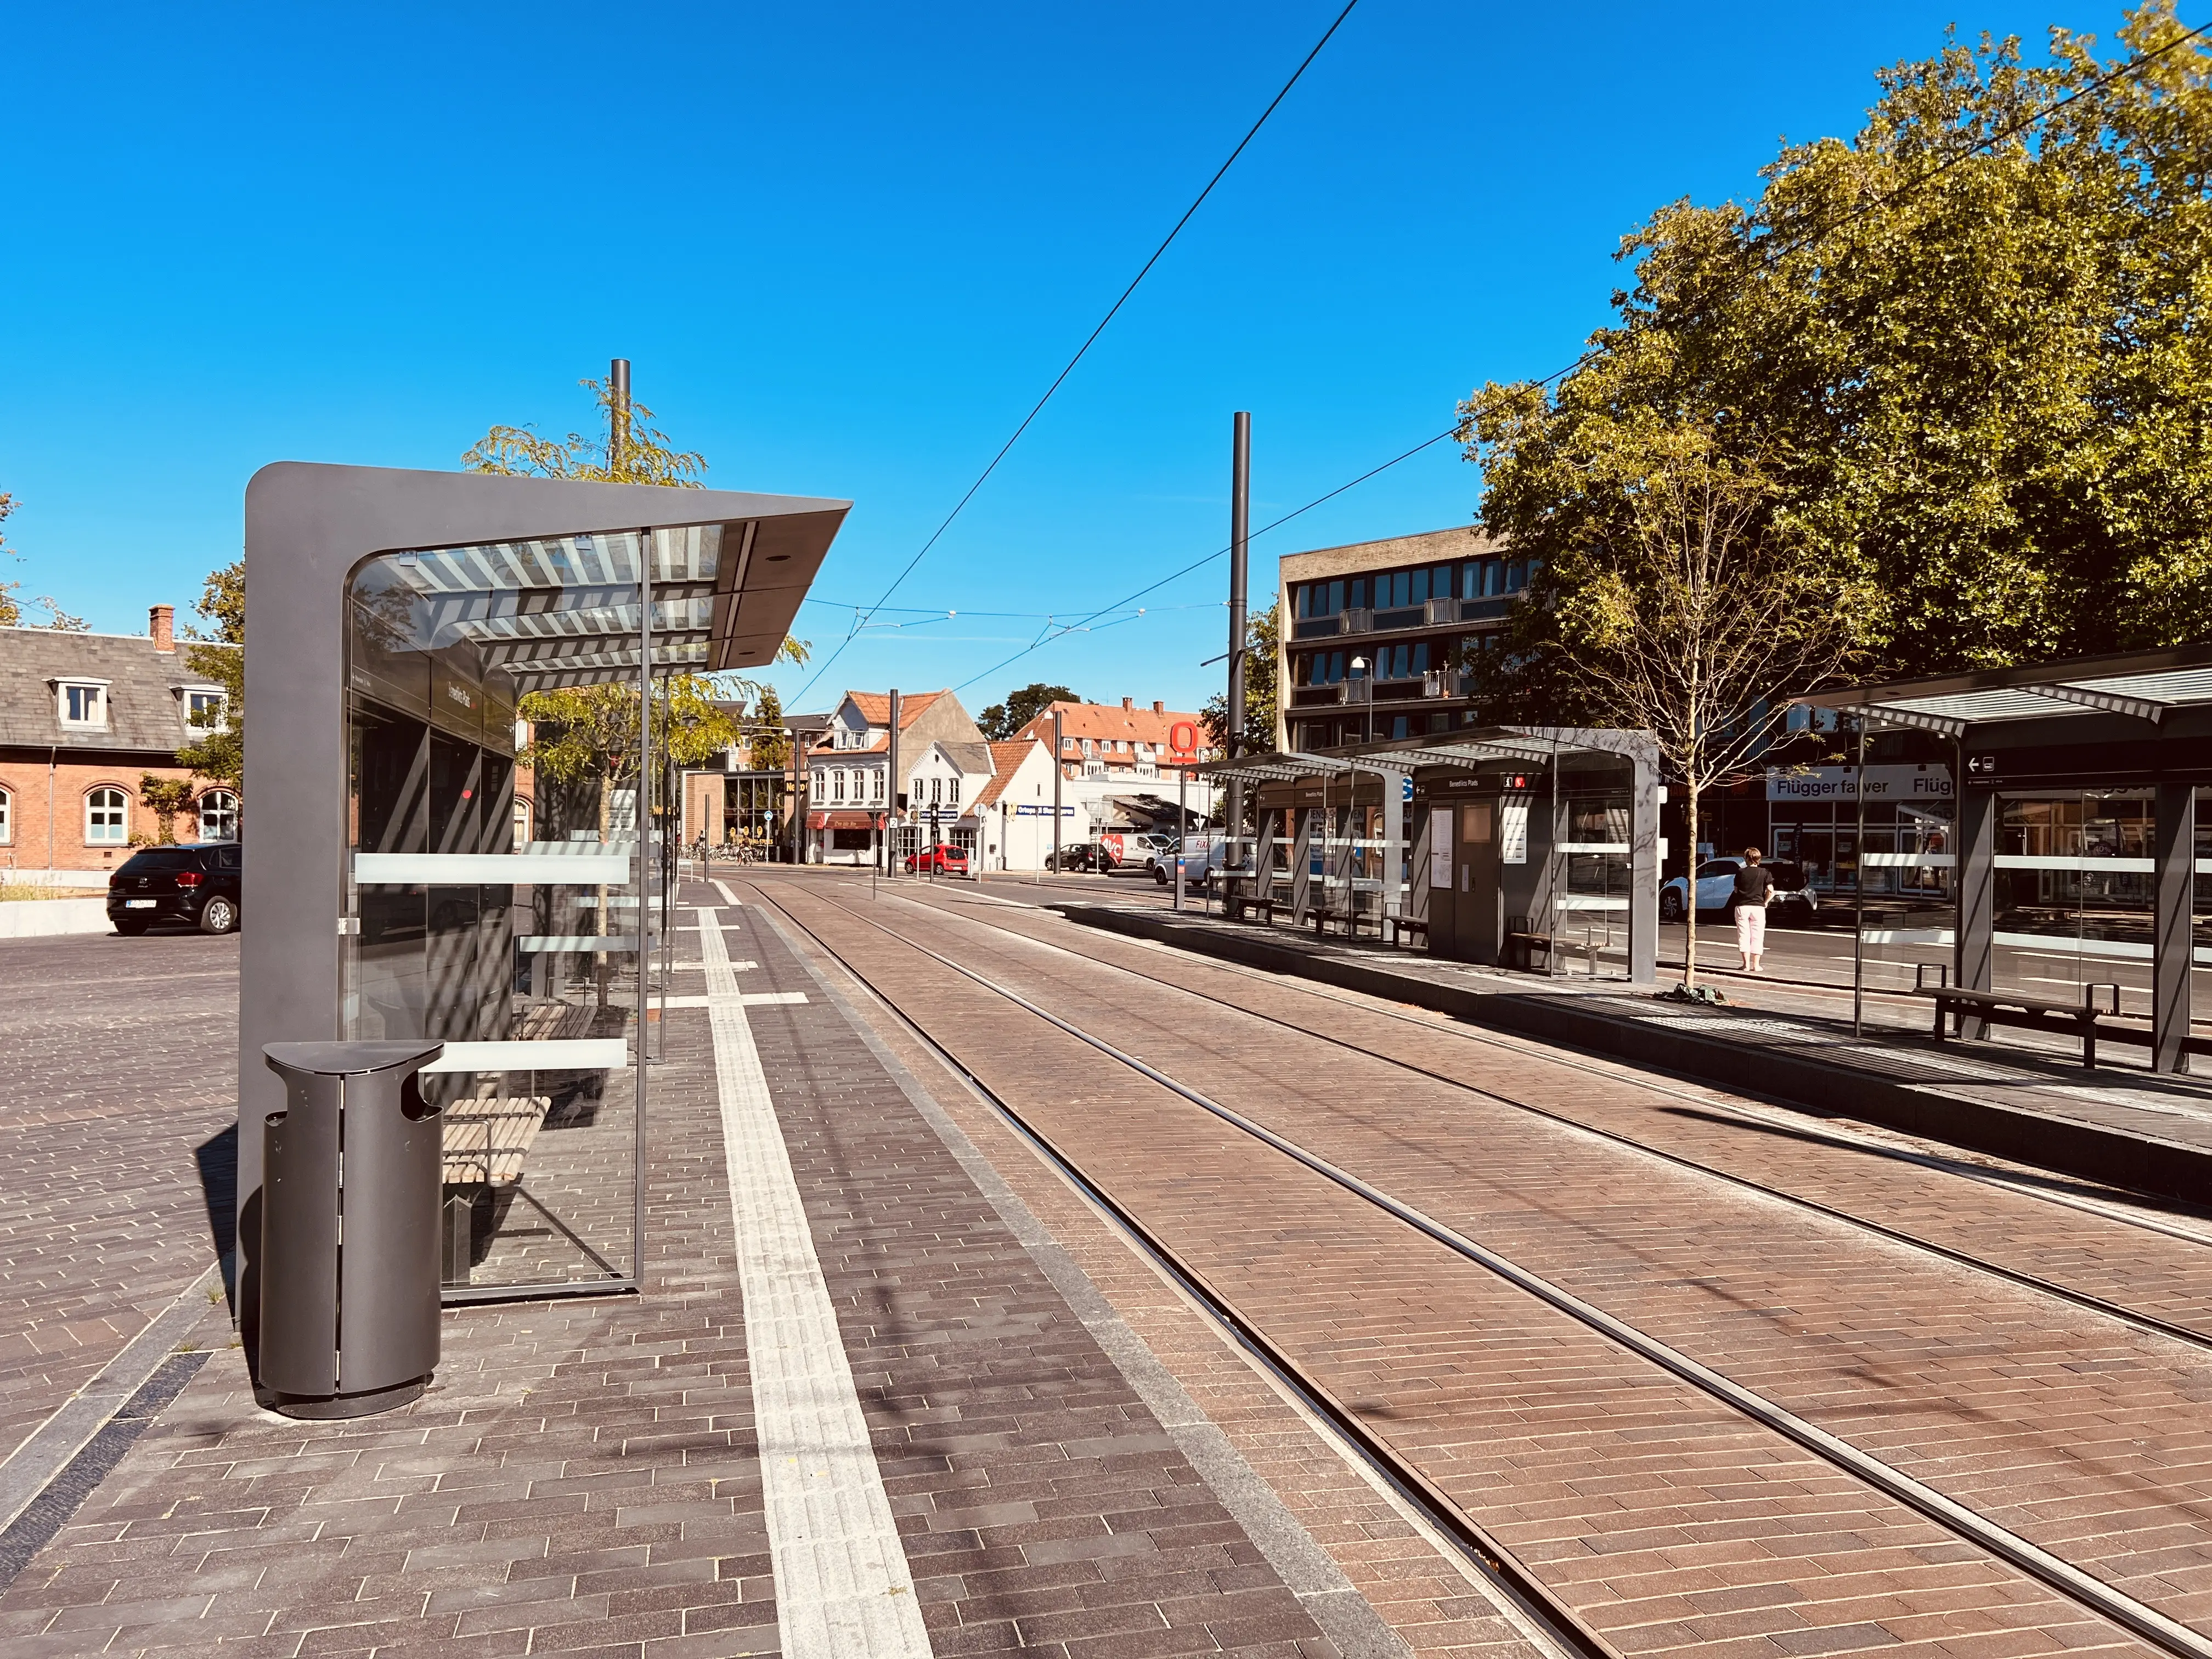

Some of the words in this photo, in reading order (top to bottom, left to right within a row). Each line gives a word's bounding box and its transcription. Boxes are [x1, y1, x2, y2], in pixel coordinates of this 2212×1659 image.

[786, 782, 805, 792] Neto
[1778, 780, 1837, 797] Flügger
[1043, 807, 1074, 816] Skomgeren
